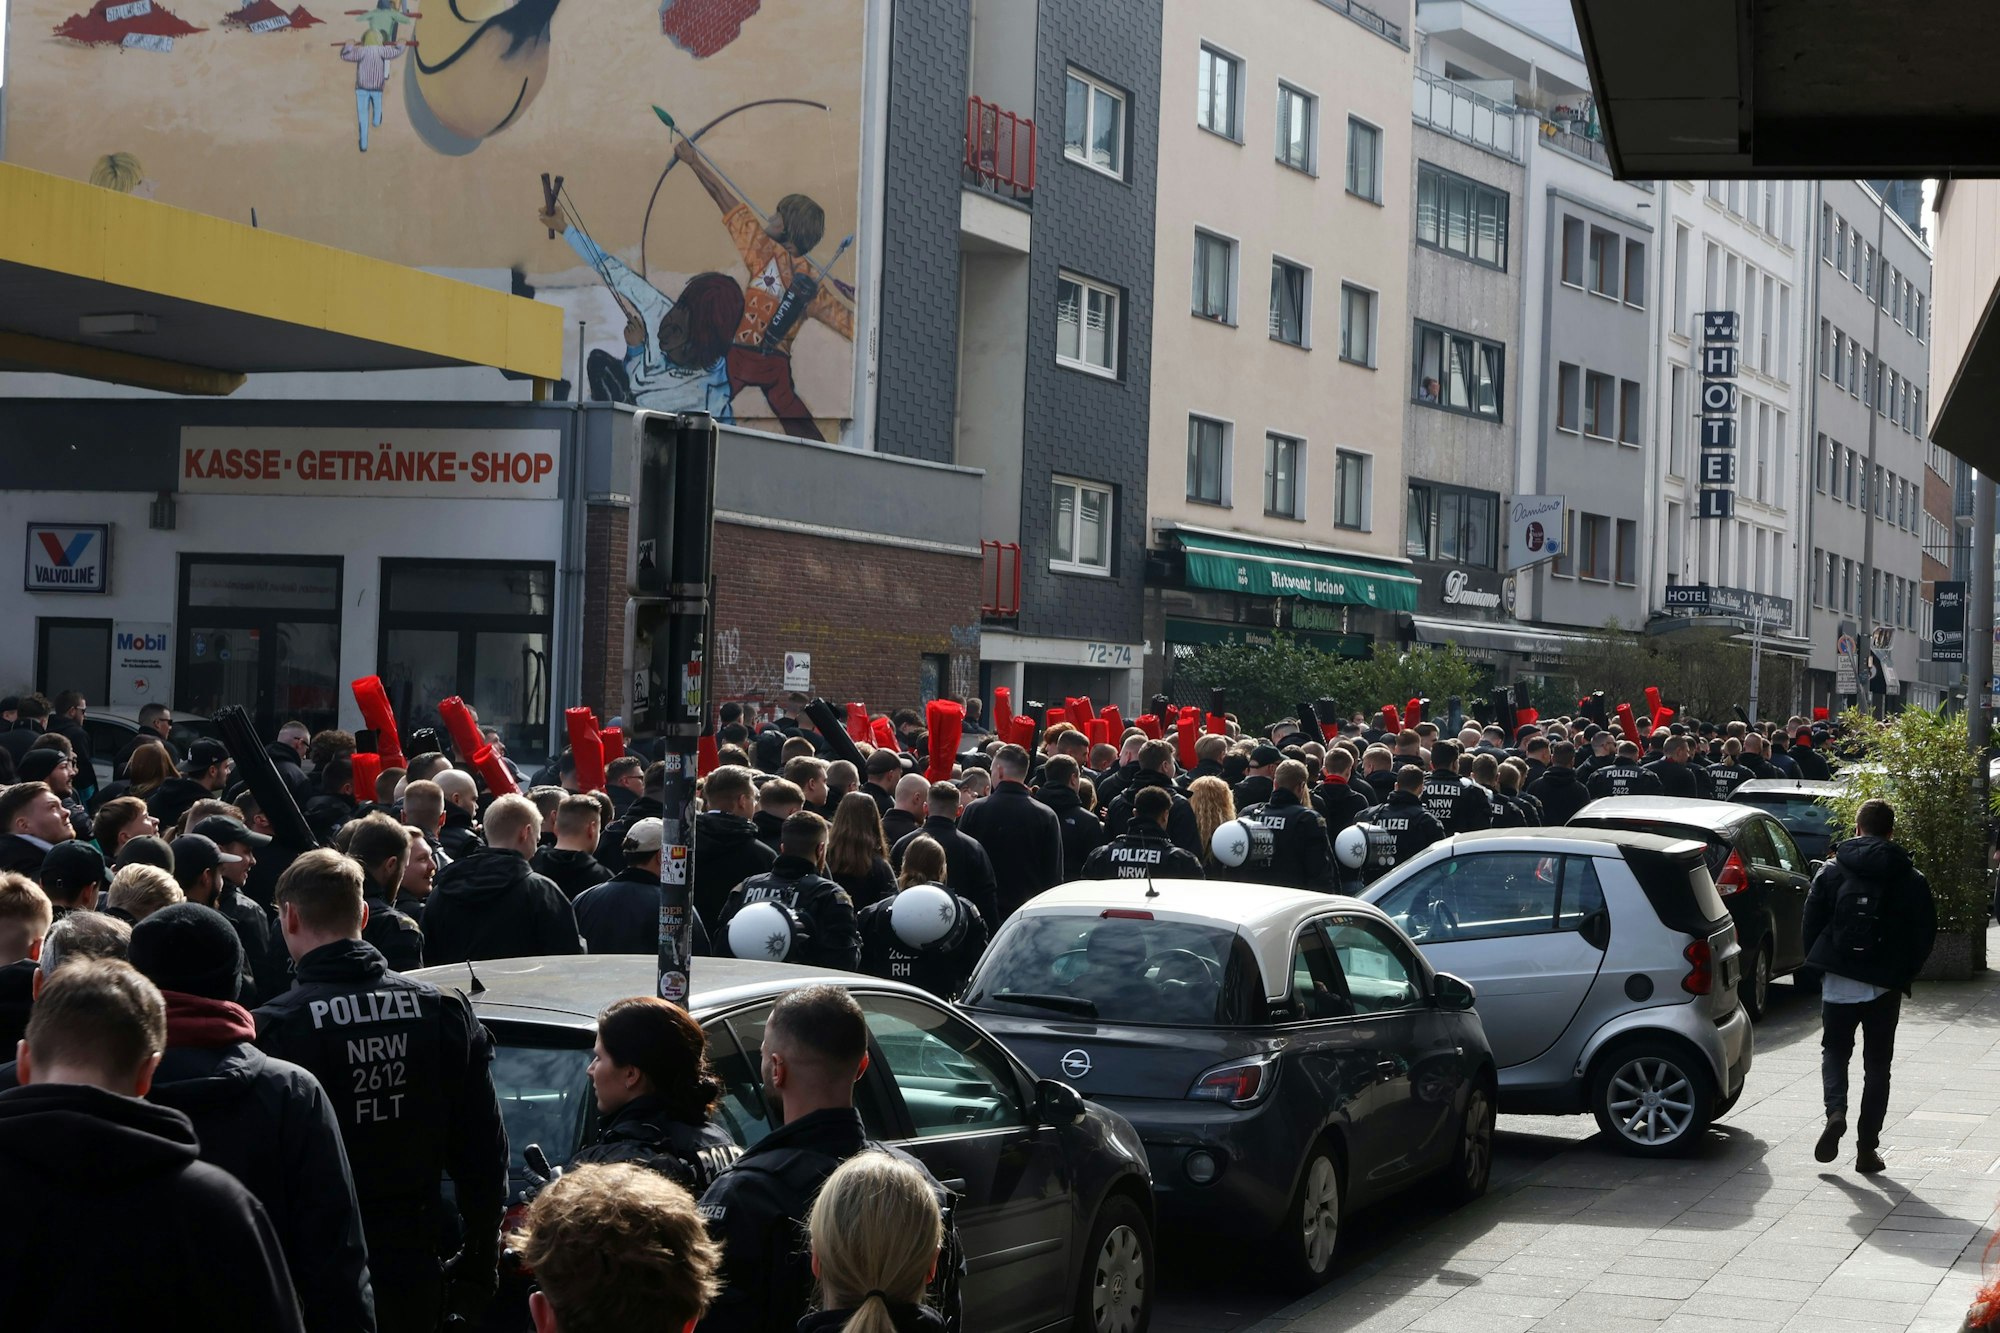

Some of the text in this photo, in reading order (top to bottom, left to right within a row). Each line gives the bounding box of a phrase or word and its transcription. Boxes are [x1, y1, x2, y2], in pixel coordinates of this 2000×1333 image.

[1705, 350, 1728, 516] HOTEL
[1512, 501, 1561, 523] Damiano
[35, 564, 95, 584] VALVOLINE
[1271, 571, 1311, 592] Ristorante
[1443, 570, 1501, 608] Damiano
[1668, 590, 1708, 602] HOTEL
[117, 633, 166, 651] Mobil
[1088, 643, 1131, 665] 72-74
[1606, 769, 1638, 779] POLIZEI
[1711, 769, 1739, 779] POLIZEI
[1612, 786, 1629, 795] 2622
[1428, 798, 1453, 809] NRW
[1110, 847, 1162, 864] POLIZEI
[1376, 844, 1398, 855] 2623
[1117, 865, 1147, 879] NRW
[891, 962, 911, 977] RH
[309, 989, 423, 1030] POLIZEI
[346, 1032, 408, 1065] NRW
[352, 1061, 407, 1094] 2612
